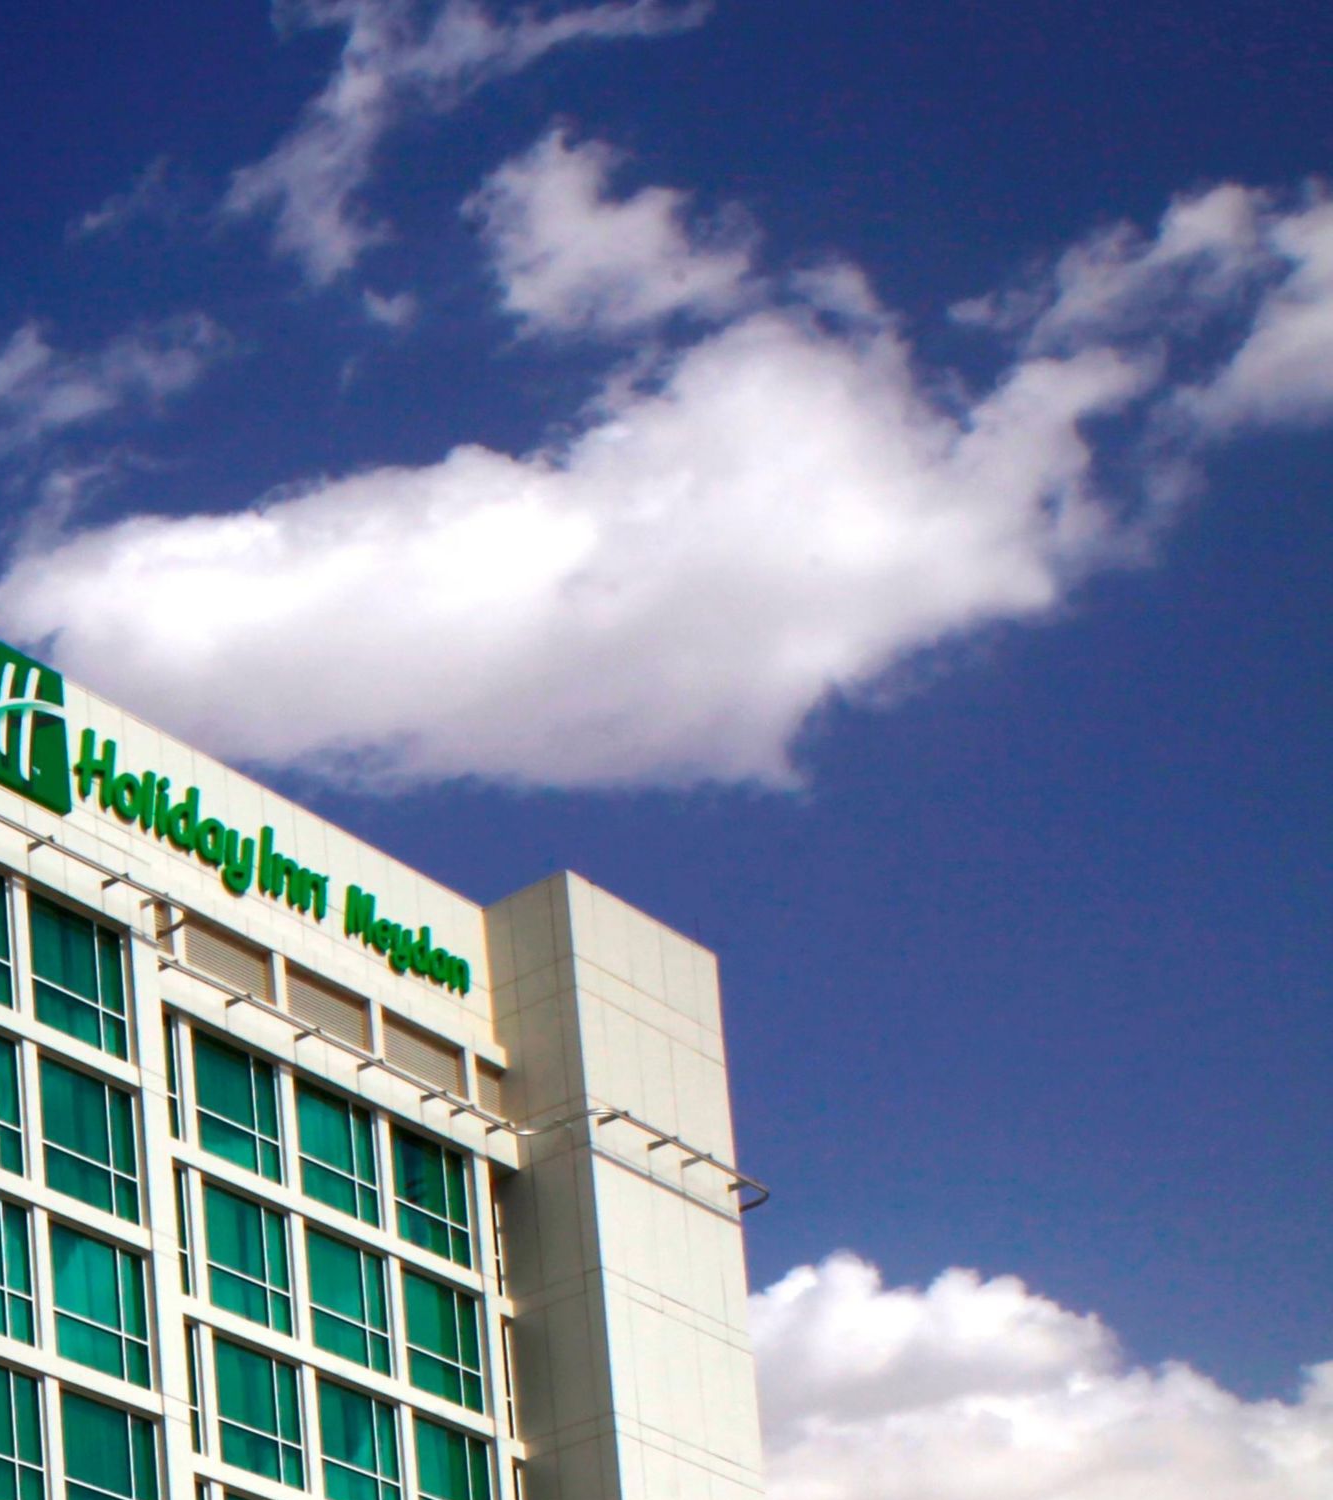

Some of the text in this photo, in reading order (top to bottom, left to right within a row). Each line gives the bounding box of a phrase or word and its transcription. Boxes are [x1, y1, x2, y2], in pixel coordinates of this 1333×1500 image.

[74, 727, 471, 998] Holiday Inn Meydan
